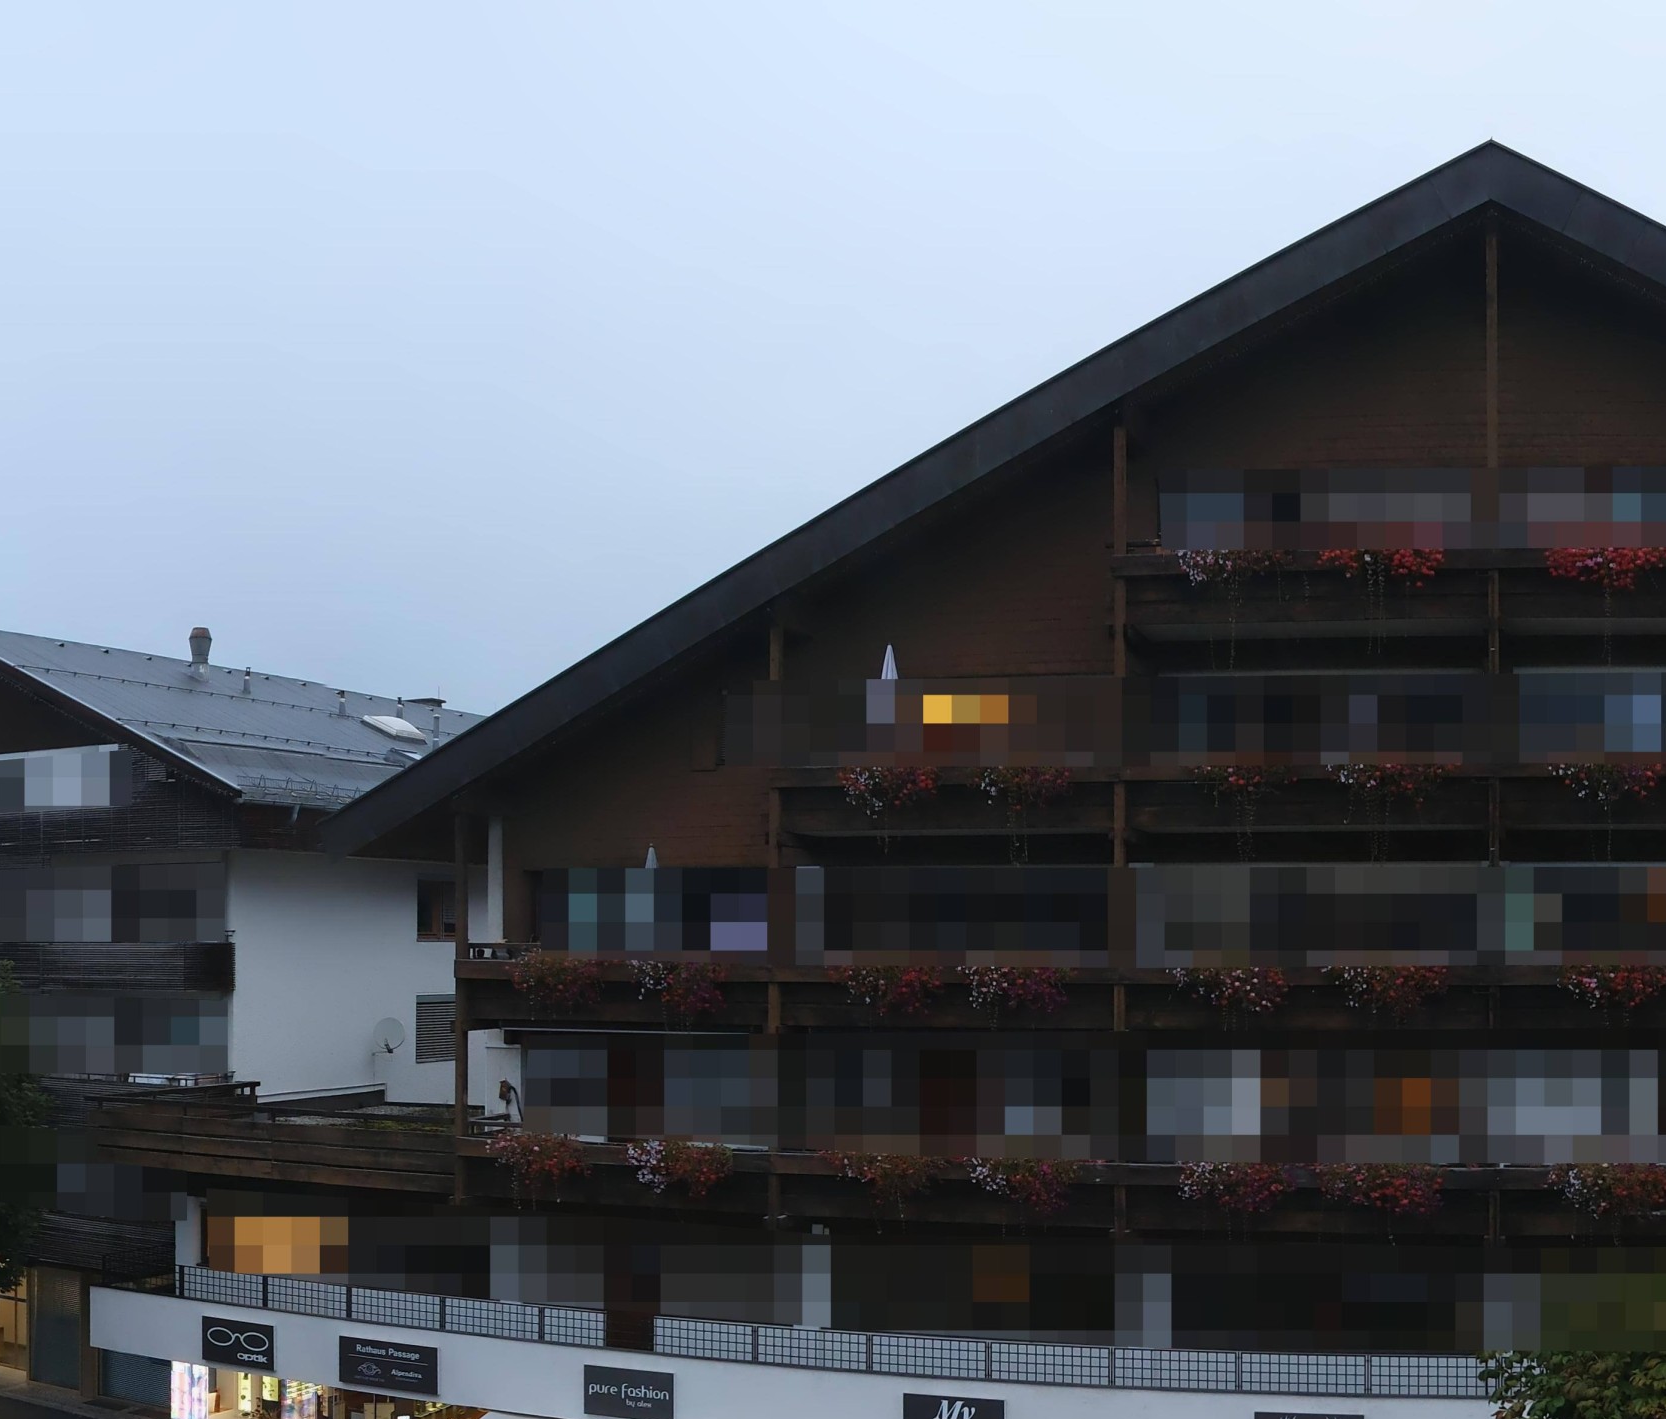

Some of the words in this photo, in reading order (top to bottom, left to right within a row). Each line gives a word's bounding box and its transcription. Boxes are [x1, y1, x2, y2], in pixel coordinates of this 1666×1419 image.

[237, 1352, 269, 1365] optik
[356, 1344, 387, 1356] Rathaus
[388, 1347, 421, 1361] Passage
[391, 1368, 423, 1380] Alpendiva
[589, 1382, 618, 1396] pure
[621, 1383, 670, 1400] fashion
[626, 1399, 636, 1408] by
[637, 1400, 652, 1409] alex
